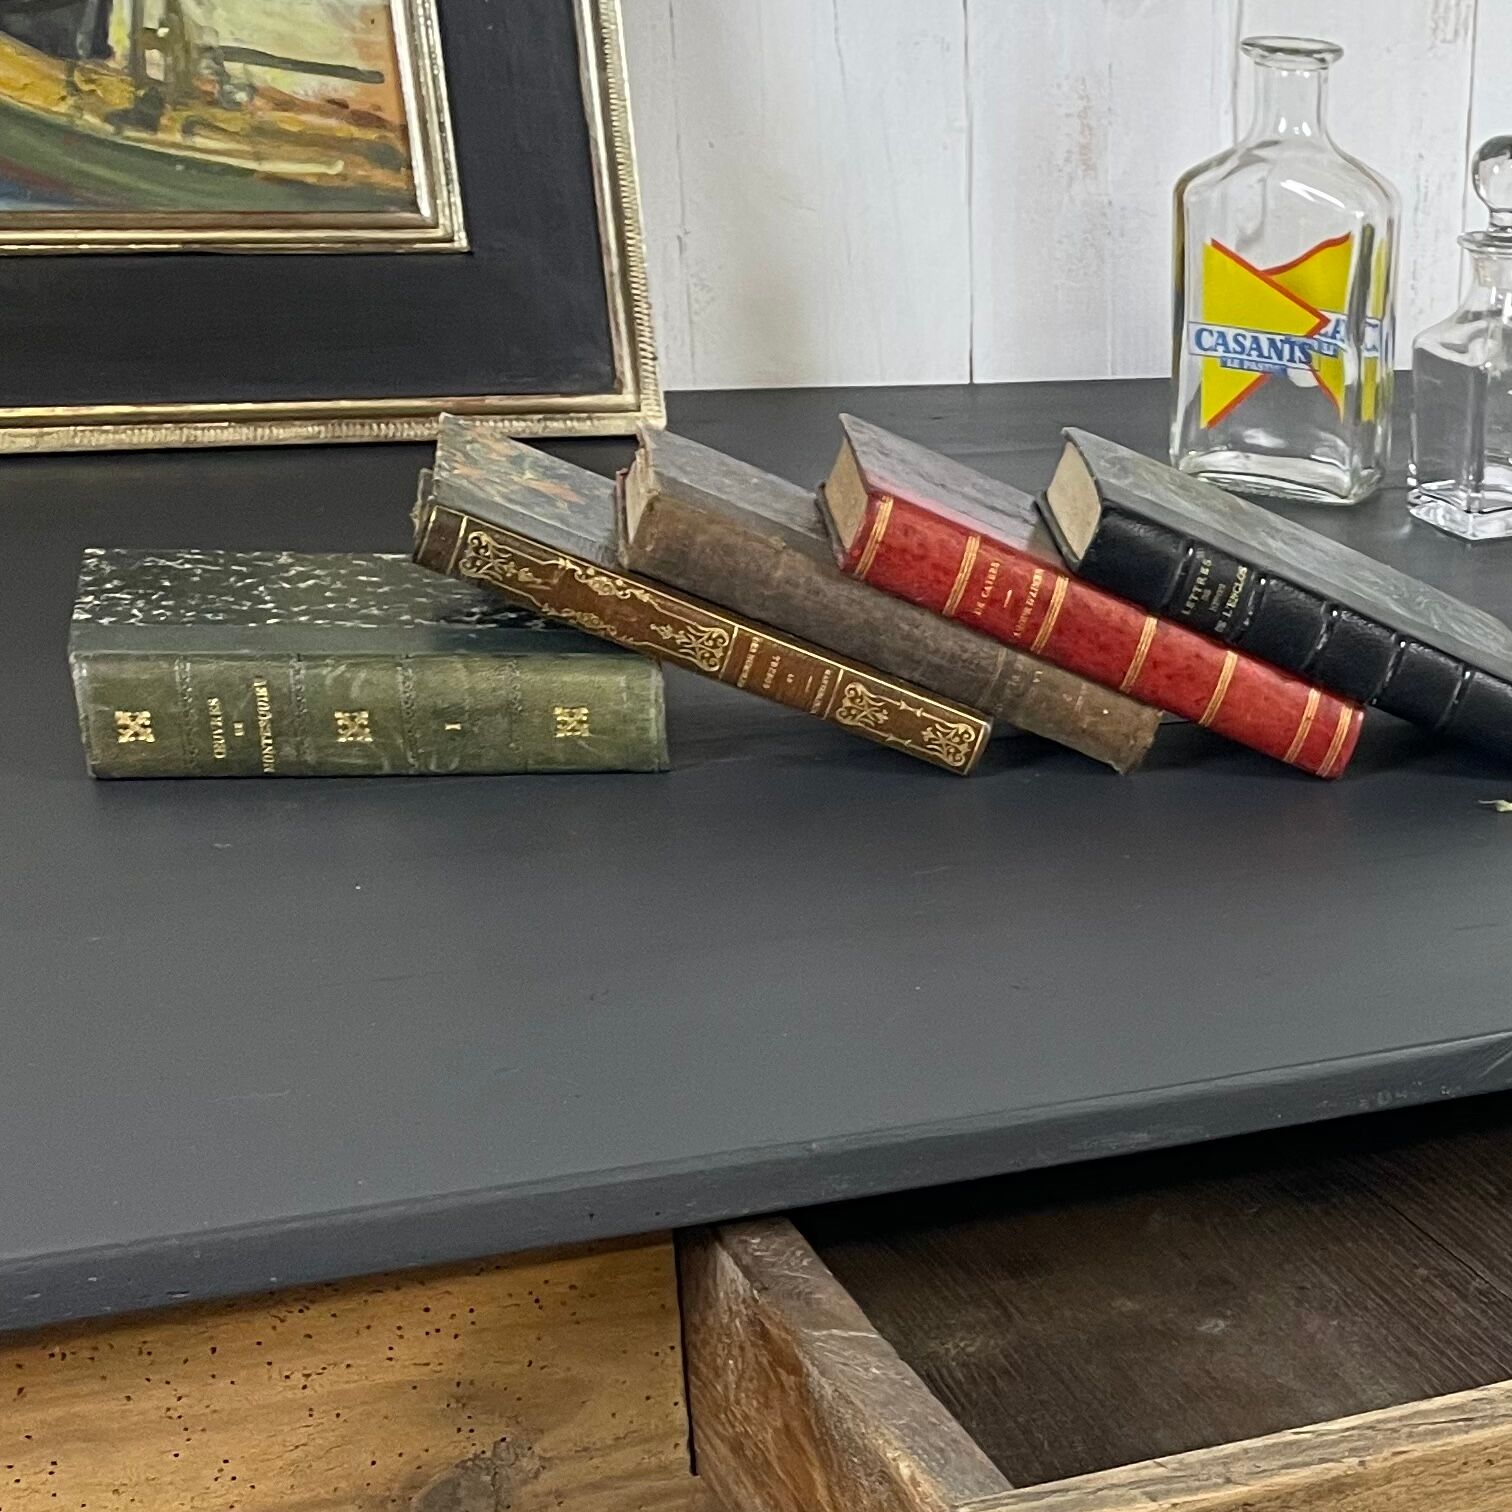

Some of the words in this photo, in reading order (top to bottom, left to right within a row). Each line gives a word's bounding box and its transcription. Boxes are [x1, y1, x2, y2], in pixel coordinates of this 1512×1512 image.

[1194, 327, 1313, 365] CASANIS
[1182, 558, 1212, 615] LETTRES
[1221, 565, 1248, 617] L'ENCLOS
